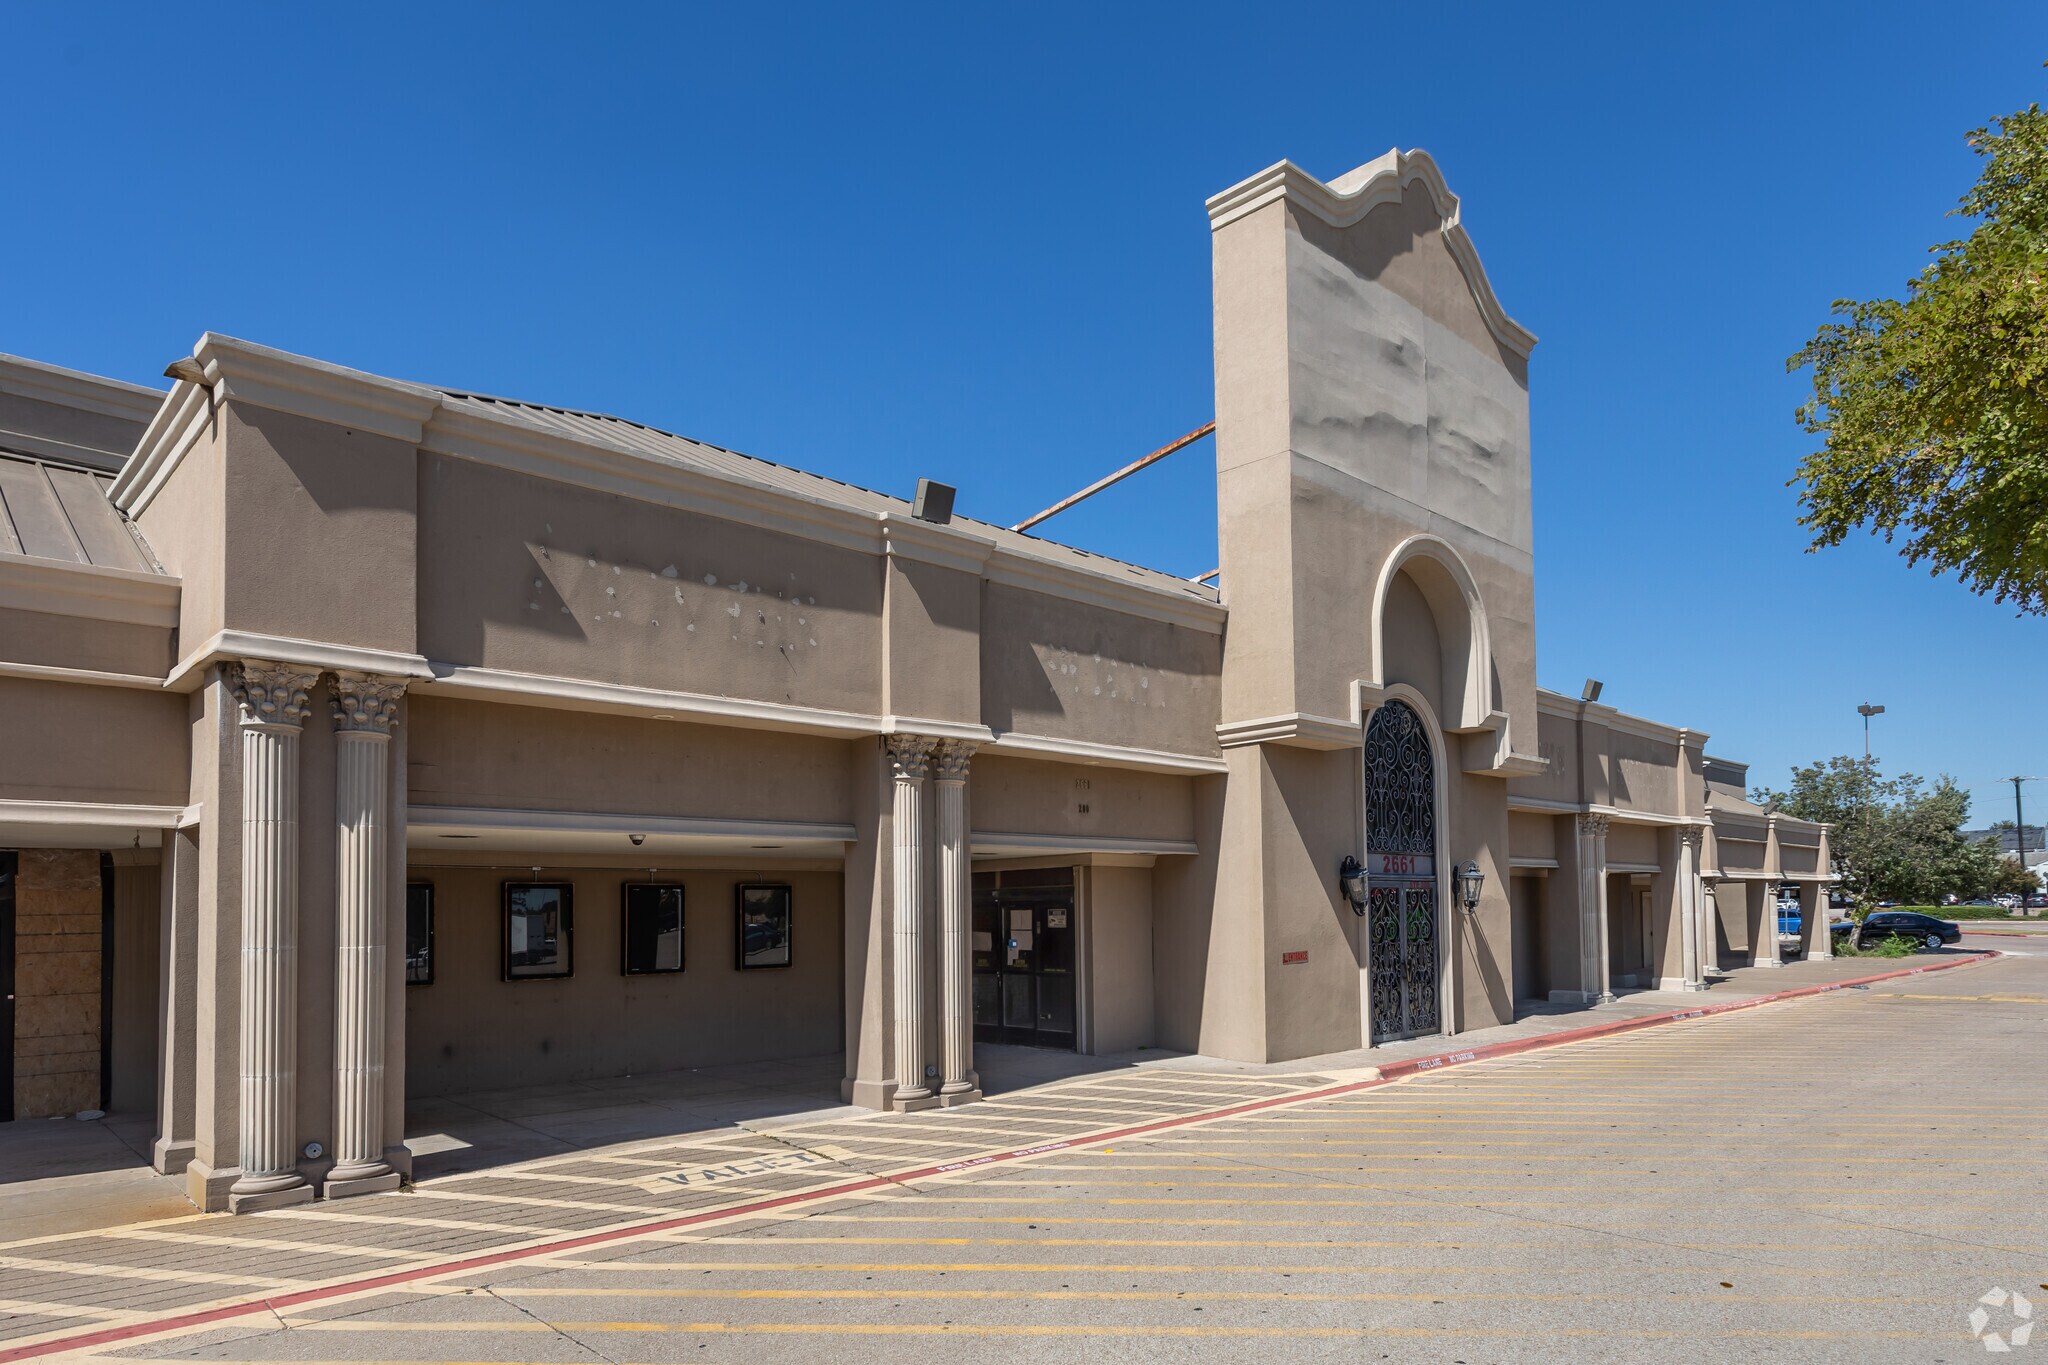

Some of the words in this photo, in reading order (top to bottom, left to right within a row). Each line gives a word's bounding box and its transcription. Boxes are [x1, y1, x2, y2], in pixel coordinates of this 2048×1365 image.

[1382, 855, 1416, 874] 2661
[1417, 1060, 1430, 1070] FIRE
[1428, 1057, 1442, 1067] LANE
[657, 1152, 817, 1186] VALET
